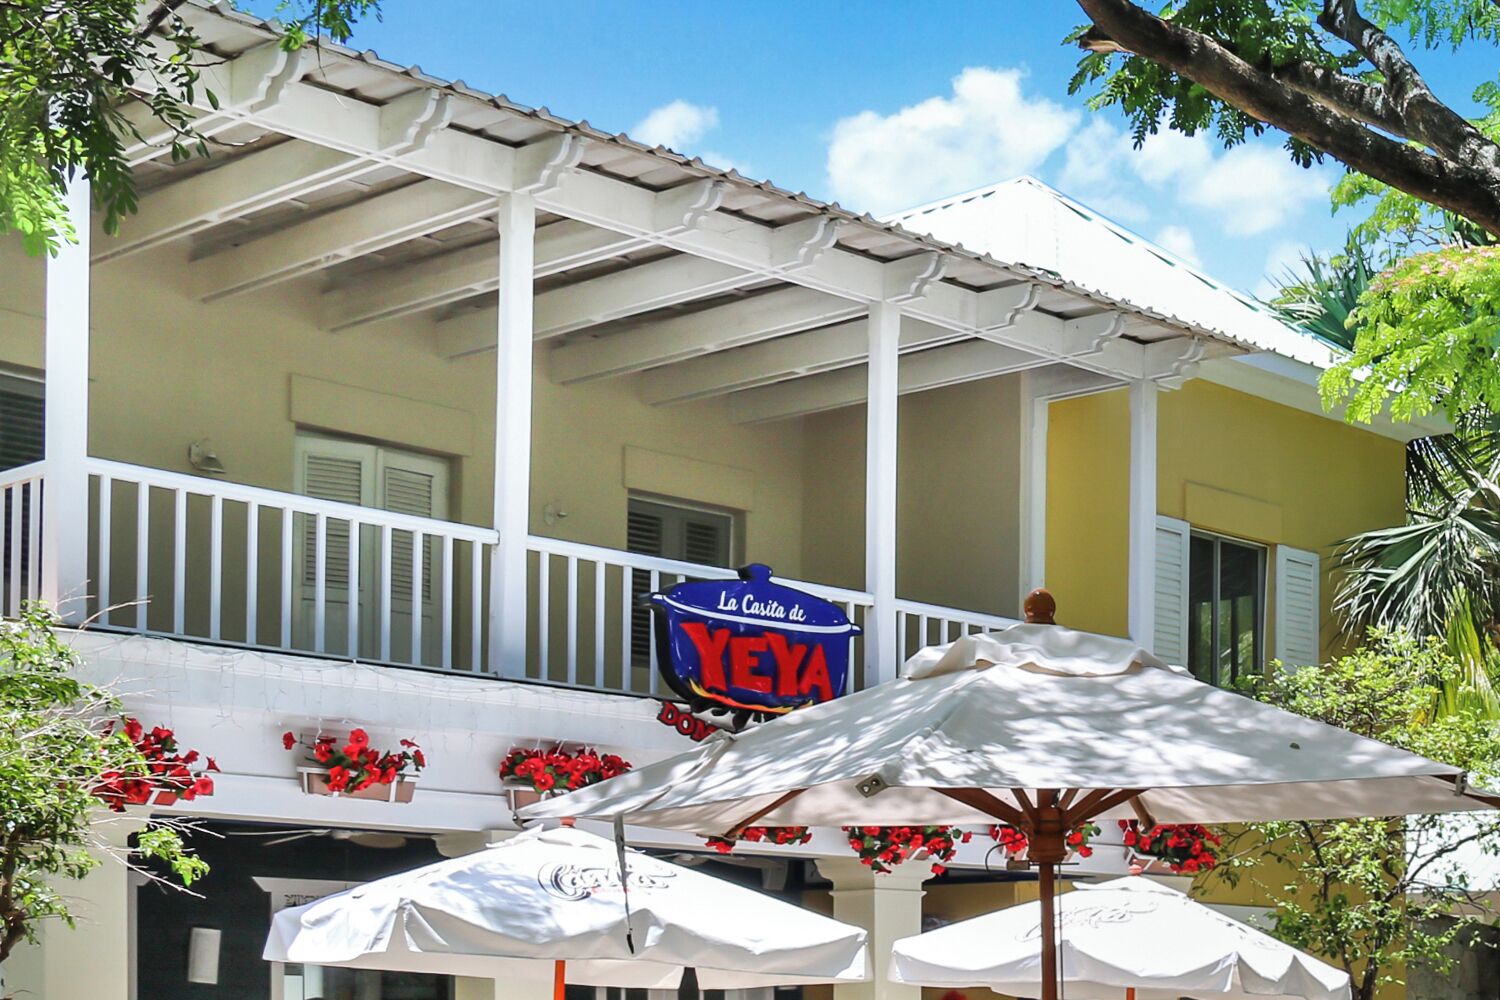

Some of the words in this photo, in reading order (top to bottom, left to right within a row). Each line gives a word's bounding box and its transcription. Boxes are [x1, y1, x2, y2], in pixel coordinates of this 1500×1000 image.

[717, 591, 738, 611] La
[742, 594, 786, 618] Casita
[789, 604, 806, 621] de
[680, 623, 834, 702] YEYA
